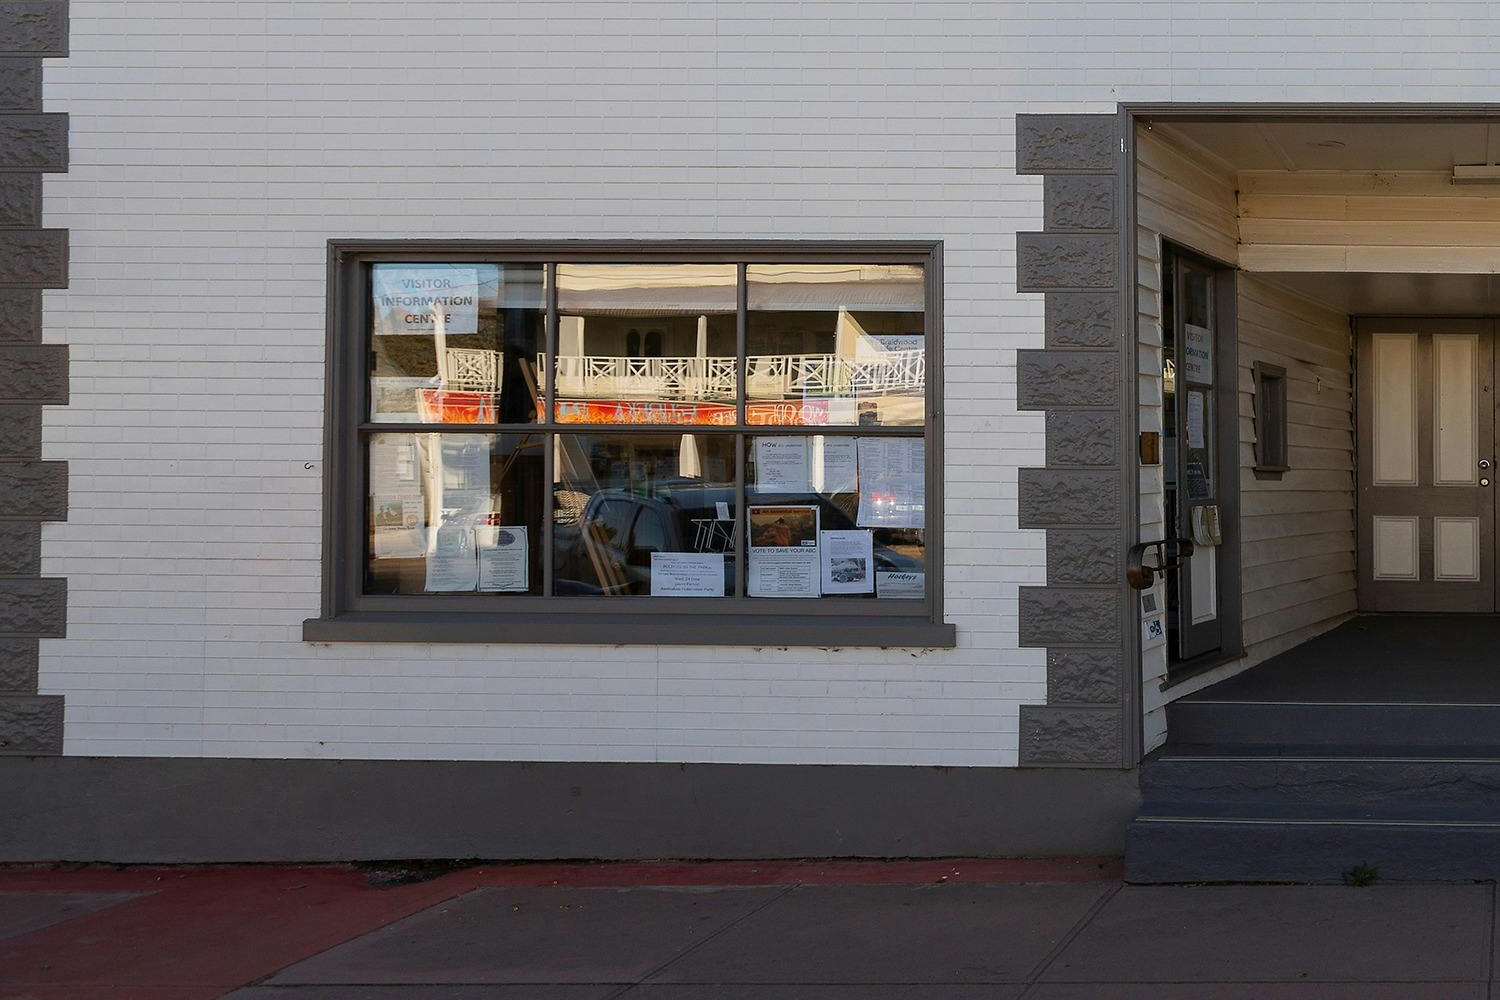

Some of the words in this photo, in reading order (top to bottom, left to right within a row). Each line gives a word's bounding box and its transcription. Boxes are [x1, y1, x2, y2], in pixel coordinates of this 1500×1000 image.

[401, 279, 452, 289] VISITOR
[382, 296, 473, 307] INFORMATION
[405, 314, 451, 324] CENTE
